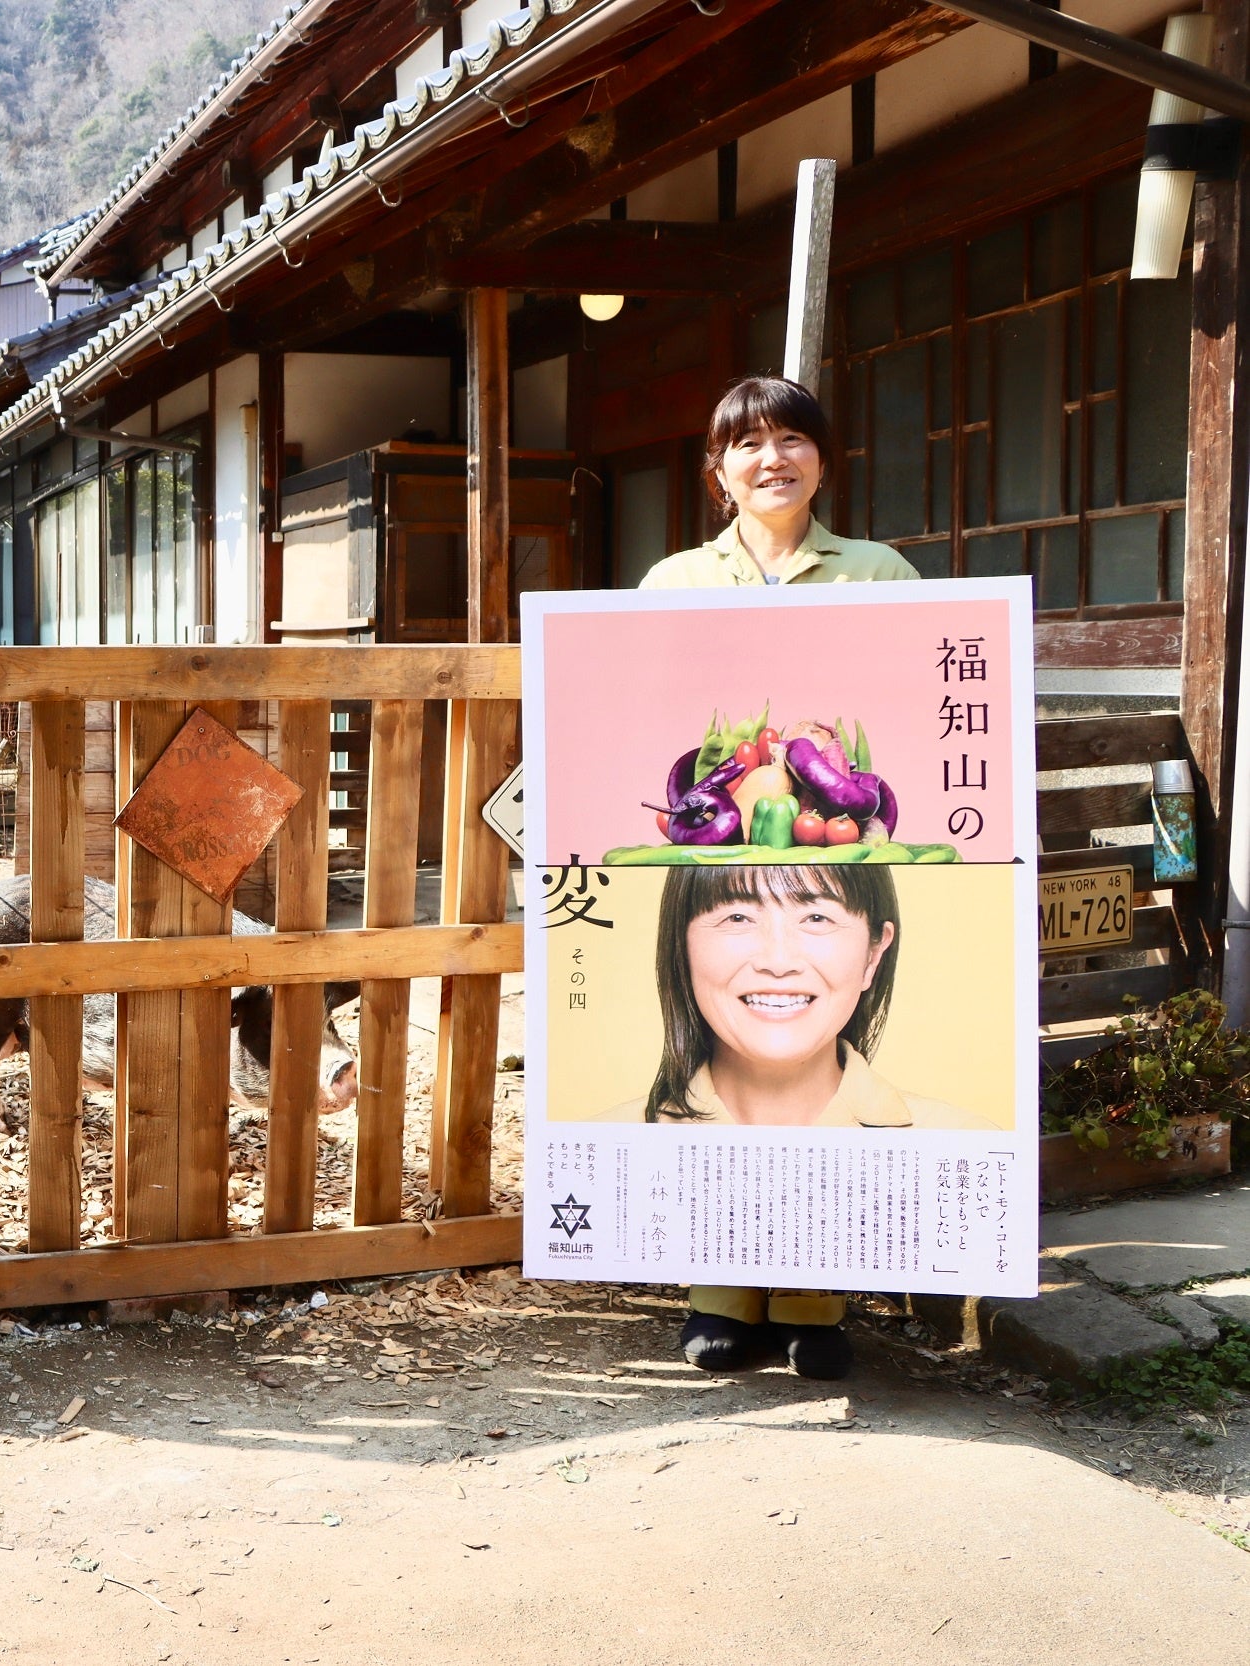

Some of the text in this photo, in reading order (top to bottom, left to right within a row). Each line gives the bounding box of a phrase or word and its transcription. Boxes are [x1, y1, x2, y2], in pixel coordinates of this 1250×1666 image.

[935, 636, 989, 841] 福知山の
[535, 853, 614, 929] 変
[1043, 875, 1121, 895] NEW YORK 48
[569, 949, 586, 1010] その四
[650, 1170, 668, 1261] 小林 加奈子
[956, 1159, 970, 1250] 農業をもっと
[976, 1161, 989, 1218] つないで
[548, 1242, 594, 1254] 福知山市
